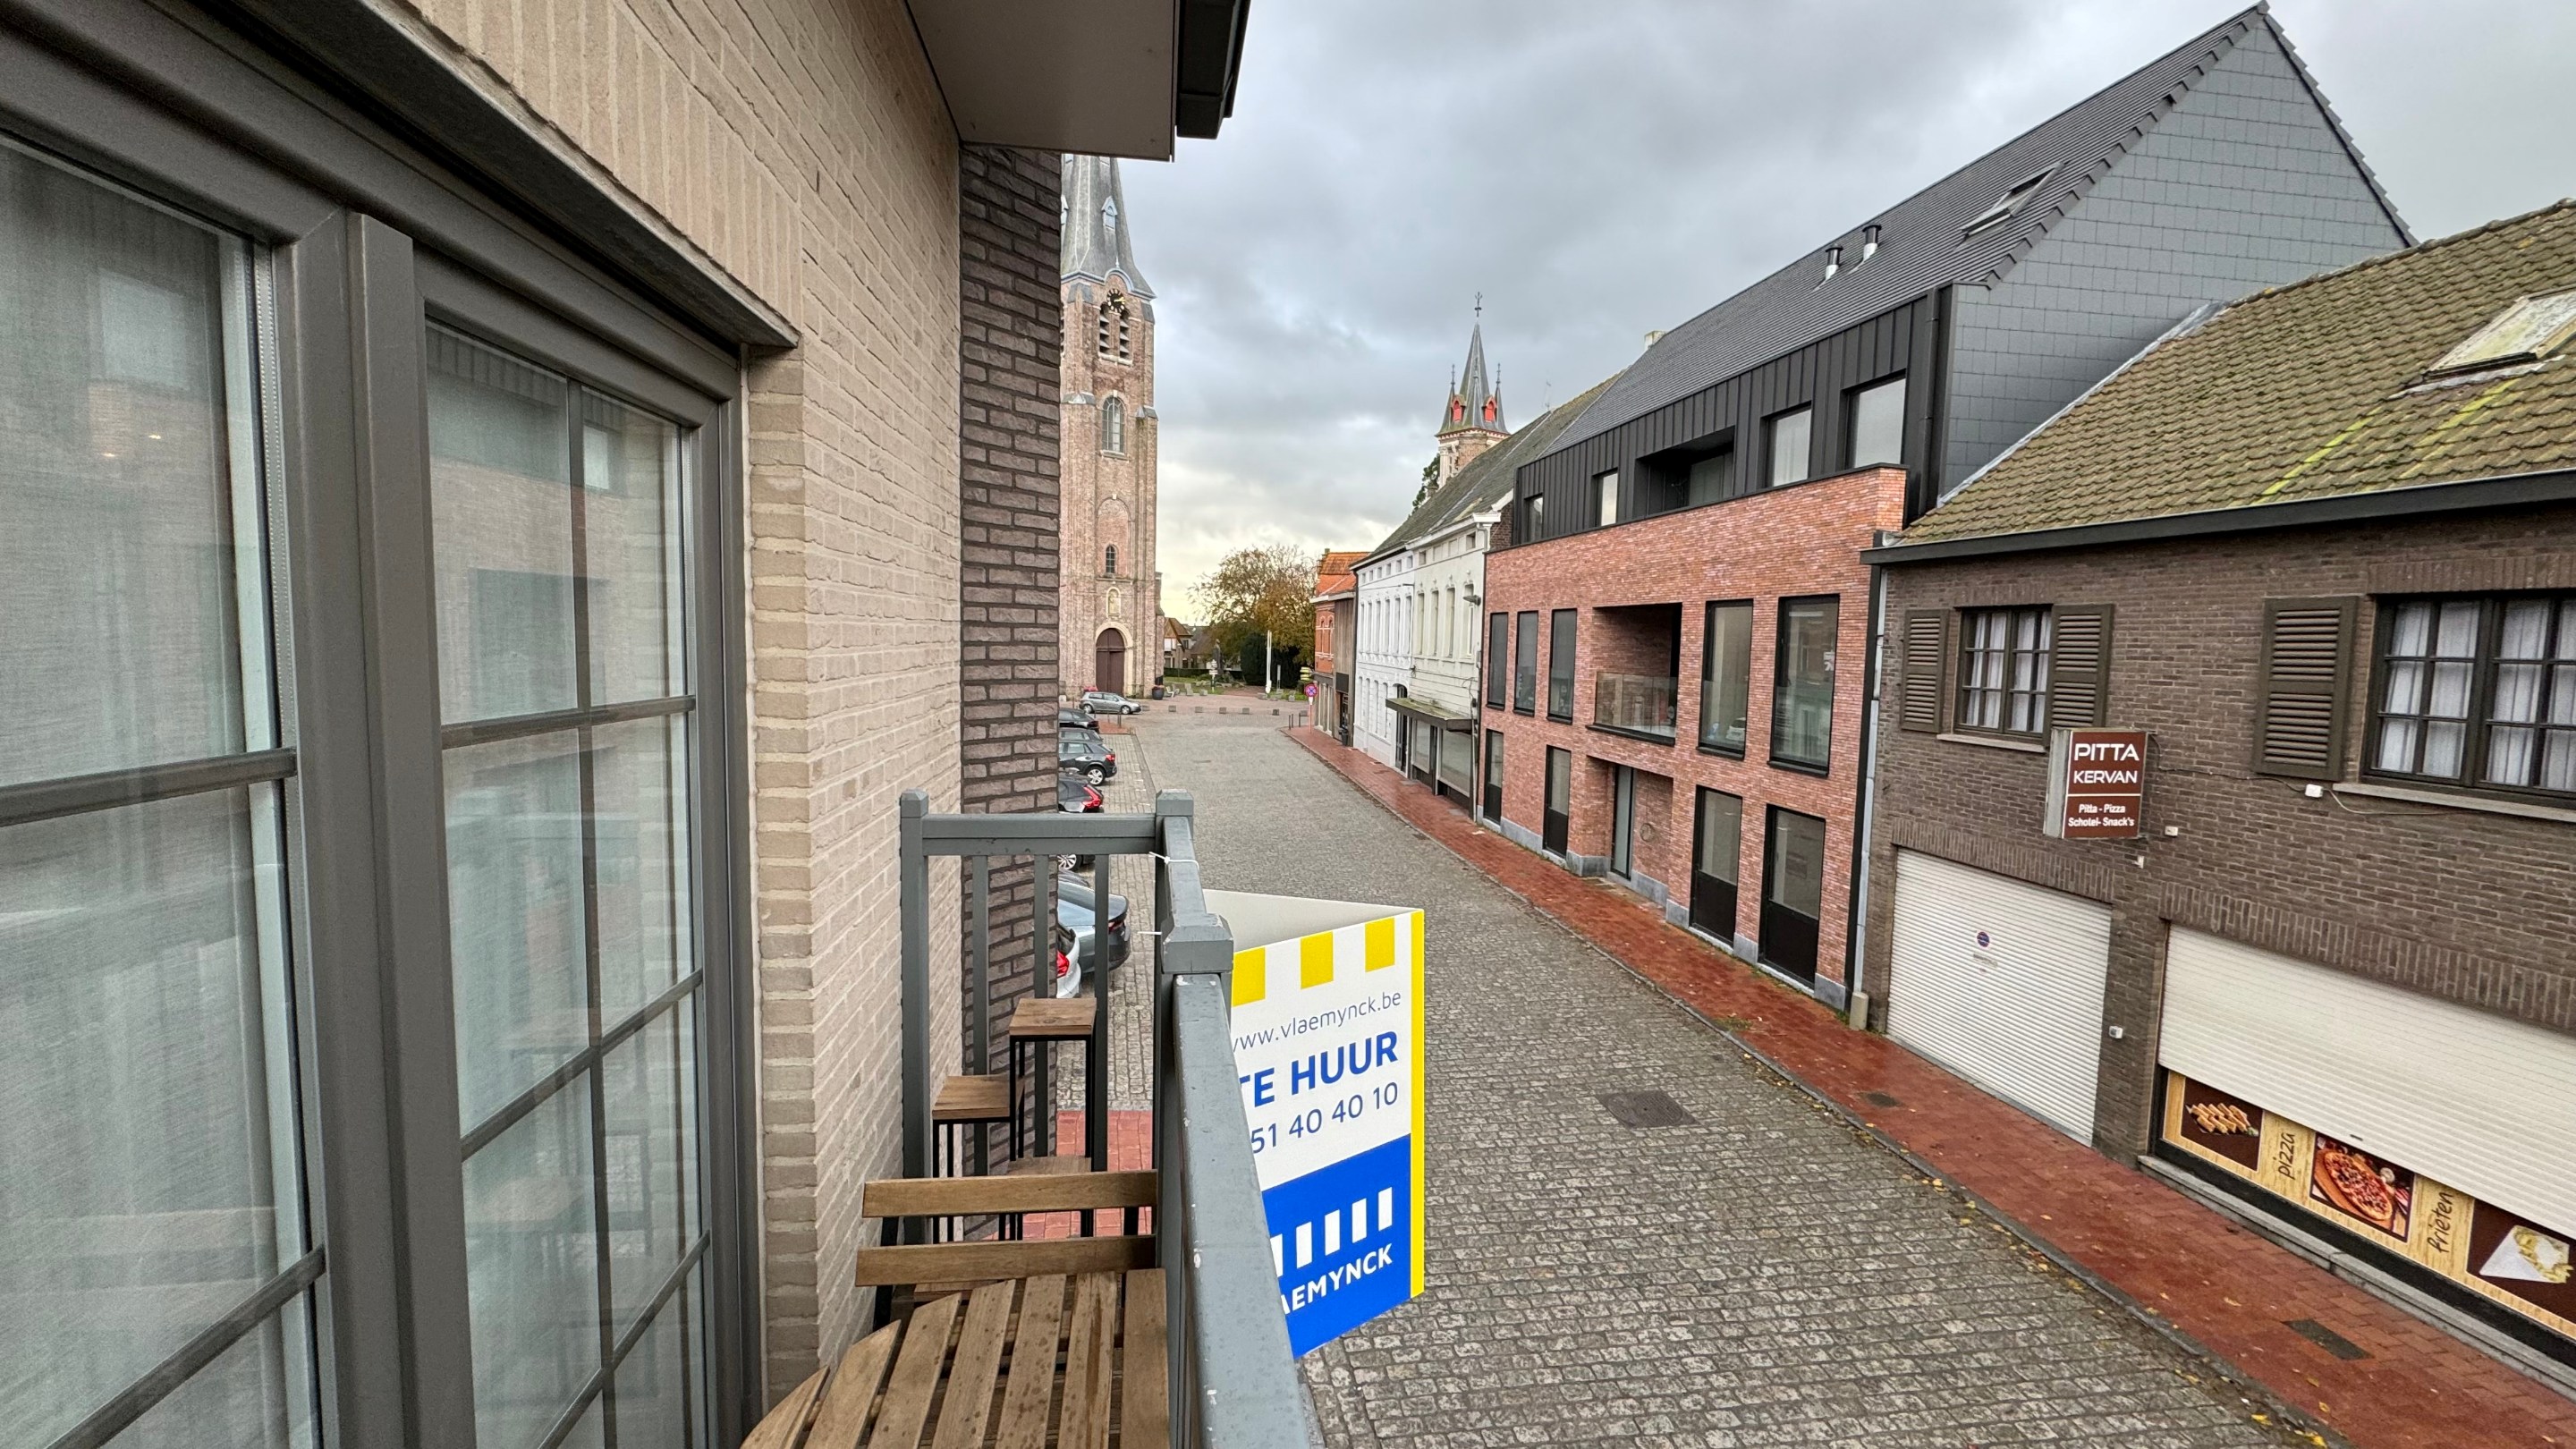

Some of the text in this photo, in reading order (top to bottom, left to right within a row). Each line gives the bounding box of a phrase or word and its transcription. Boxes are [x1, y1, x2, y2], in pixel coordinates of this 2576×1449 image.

[2073, 770, 2138, 784] KERVAN
[2074, 743, 2140, 761] PITTA
[2079, 804, 2097, 814] Pitta
[2104, 803, 2126, 814] Pizza
[2102, 817, 2135, 826] Snack's
[1233, 991, 1402, 1053] ww.vlaemynck.be
[1291, 1030, 1399, 1096] HUUR
[1289, 1108, 1322, 1139] 40
[1332, 1094, 1363, 1123] 40
[1373, 1081, 1398, 1110] 10
[2273, 1131, 2295, 1181] pizza
[2427, 1191, 2454, 1253] frieten
